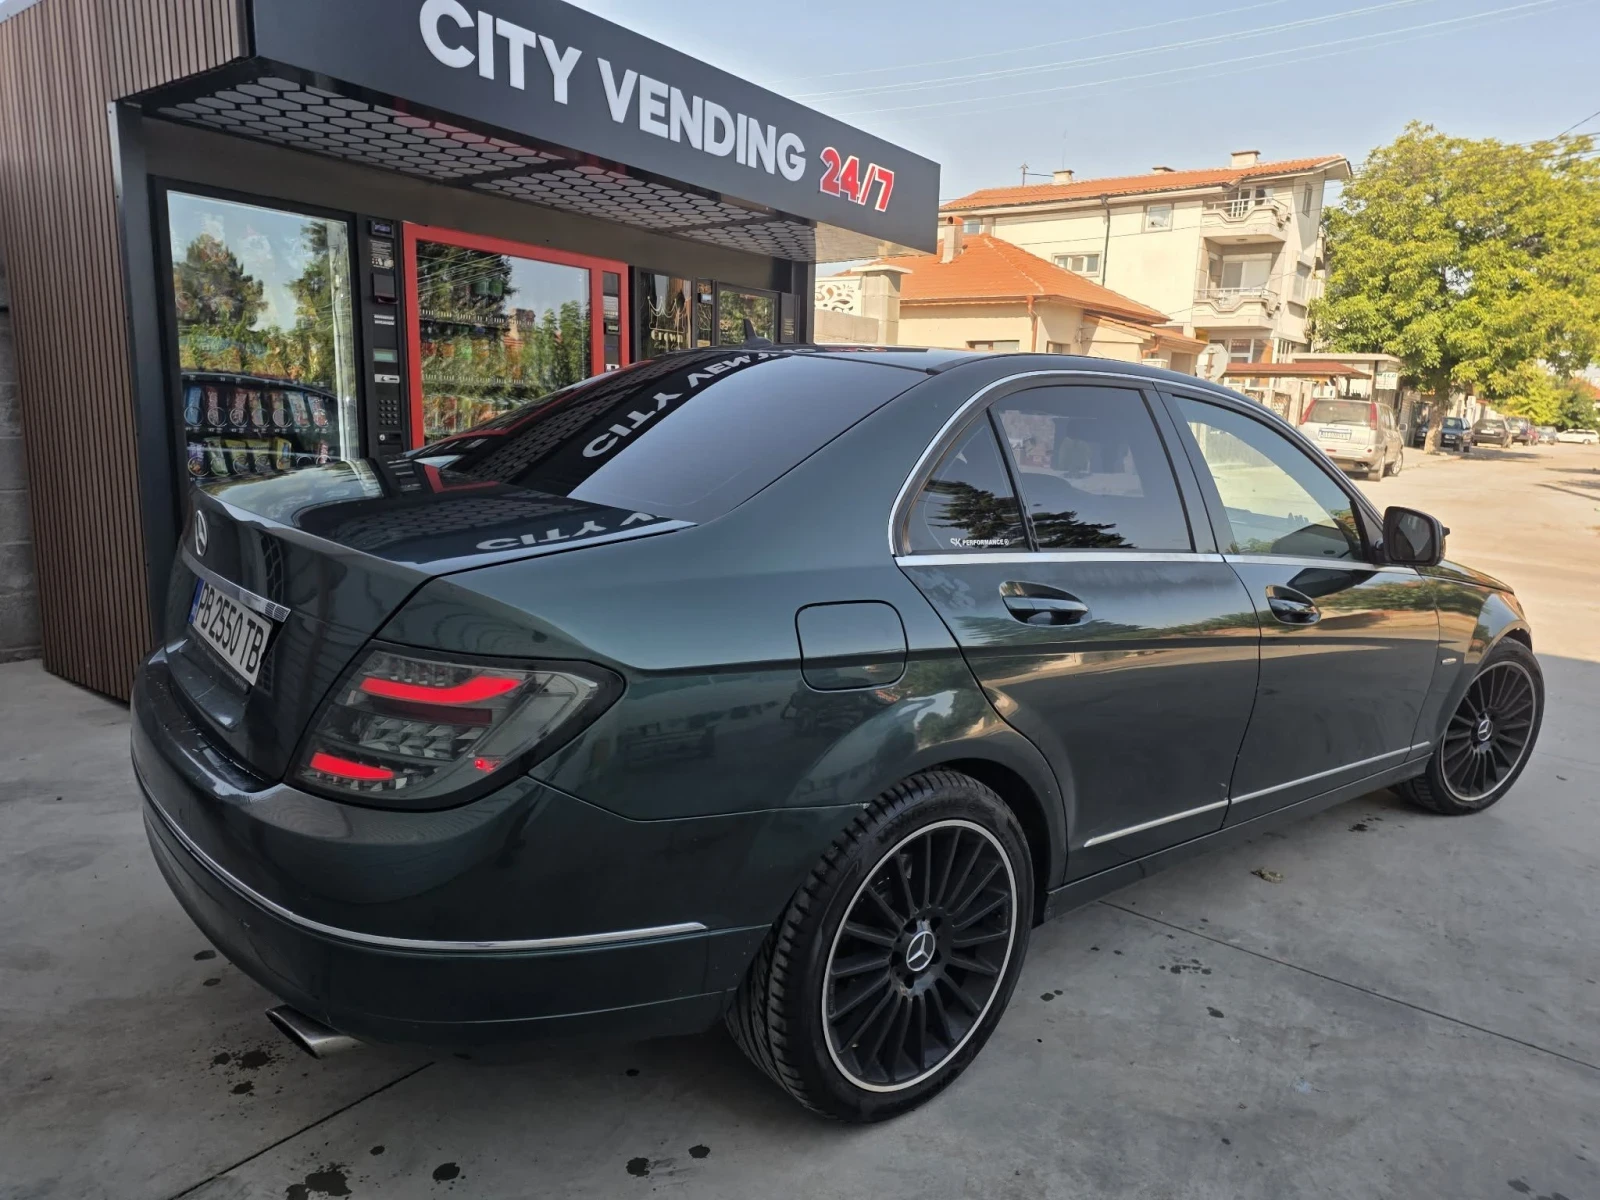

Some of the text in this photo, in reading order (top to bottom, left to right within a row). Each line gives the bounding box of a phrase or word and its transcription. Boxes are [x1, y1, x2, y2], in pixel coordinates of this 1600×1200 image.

[419, 0, 895, 212] CITY VENDING 24/7
[651, 329, 684, 343] Crown
[208, 595, 243, 656] 2550
[240, 618, 264, 674] TB
